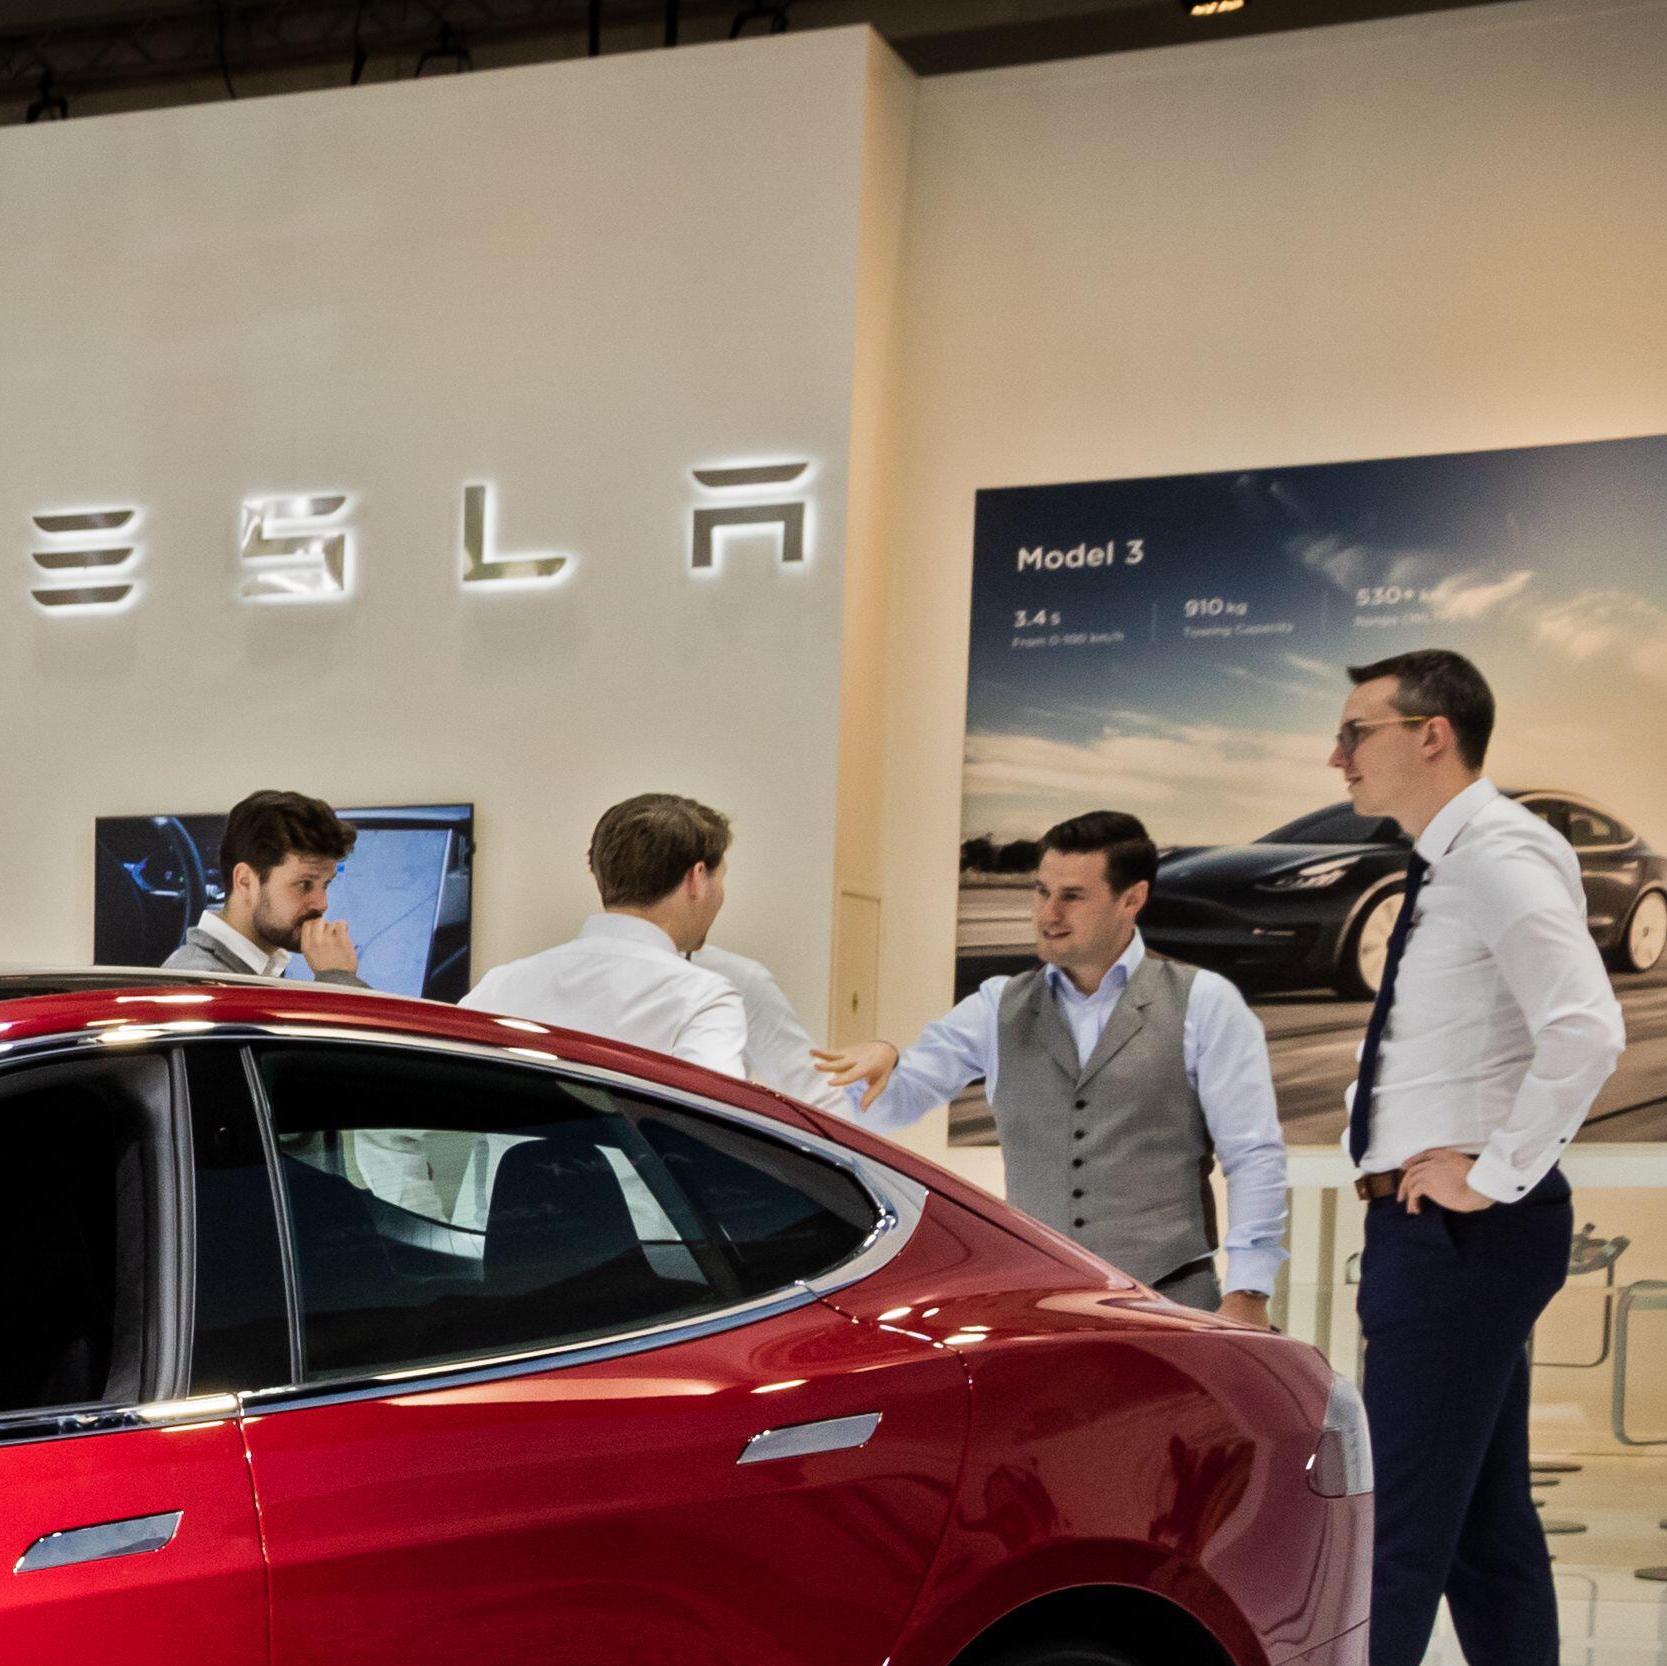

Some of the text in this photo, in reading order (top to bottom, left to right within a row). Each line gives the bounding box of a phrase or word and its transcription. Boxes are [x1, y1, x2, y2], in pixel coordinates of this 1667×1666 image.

[1017, 539, 1145, 573] Model 3
[1184, 598, 1248, 618] 910 kg
[1013, 609, 1061, 628] 3.4 s
